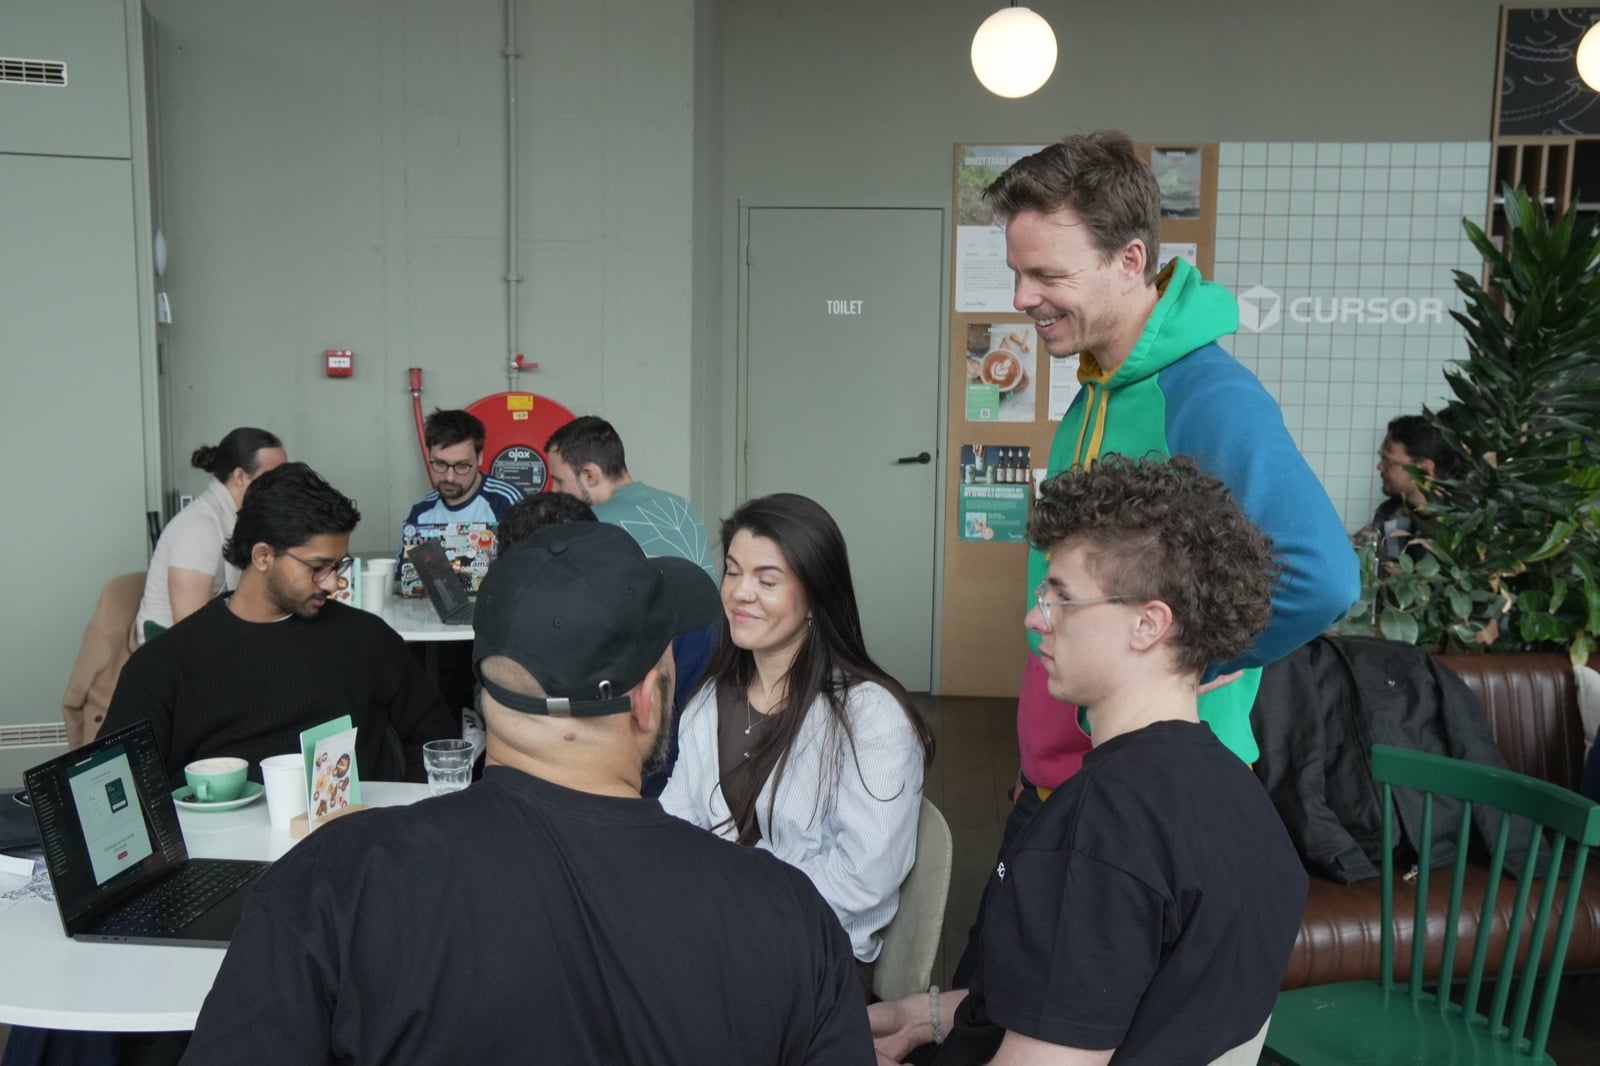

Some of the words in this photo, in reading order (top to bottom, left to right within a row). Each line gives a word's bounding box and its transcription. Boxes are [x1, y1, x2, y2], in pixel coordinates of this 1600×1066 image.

[826, 300, 863, 315] TOILET
[1289, 297, 1443, 324] CURSOR
[508, 448, 530, 461] ajax
